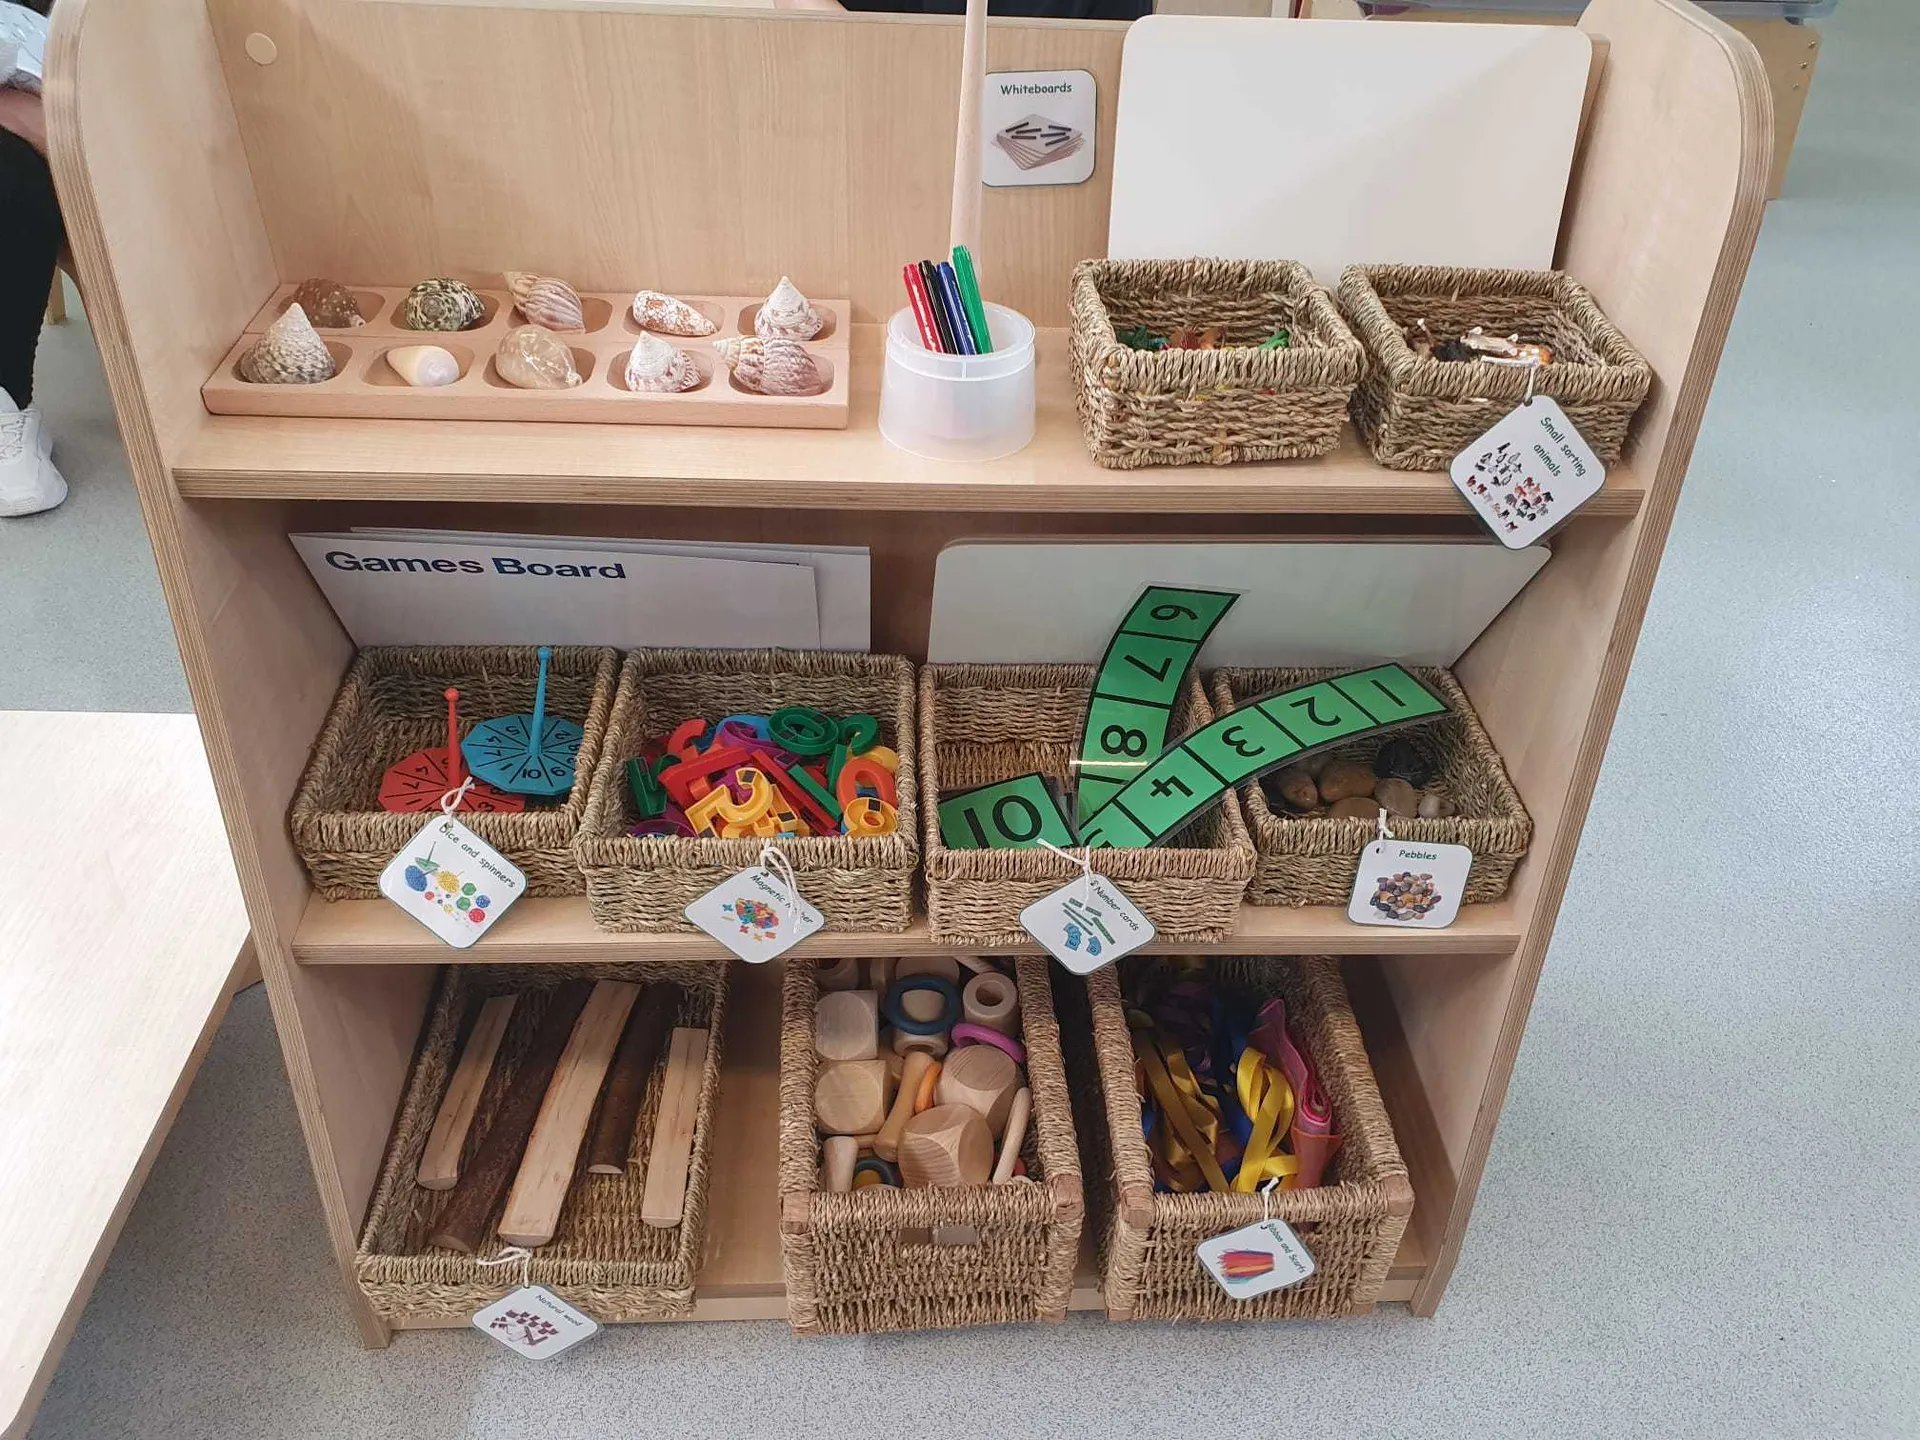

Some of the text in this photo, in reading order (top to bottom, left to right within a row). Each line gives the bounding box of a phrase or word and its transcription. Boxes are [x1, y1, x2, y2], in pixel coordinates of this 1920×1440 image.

[1000, 82, 1072, 95] Whiteboards
[1533, 443, 1561, 478] animals
[1540, 416, 1587, 478] Small sorting
[325, 551, 627, 579] Games Board
[1123, 655, 1173, 682] 7
[1289, 696, 1342, 727] 2
[1100, 724, 1148, 757] 8
[1221, 725, 1266, 758] 3
[522, 769, 542, 779] 10
[1150, 775, 1194, 798] 4
[963, 795, 1042, 849] 10
[439, 822, 516, 888] Dice and spinners
[1399, 849, 1437, 860] Pebbles
[750, 874, 785, 904] Magnetic
[1093, 886, 1139, 932] Number cards
[1280, 1242, 1294, 1254] and
